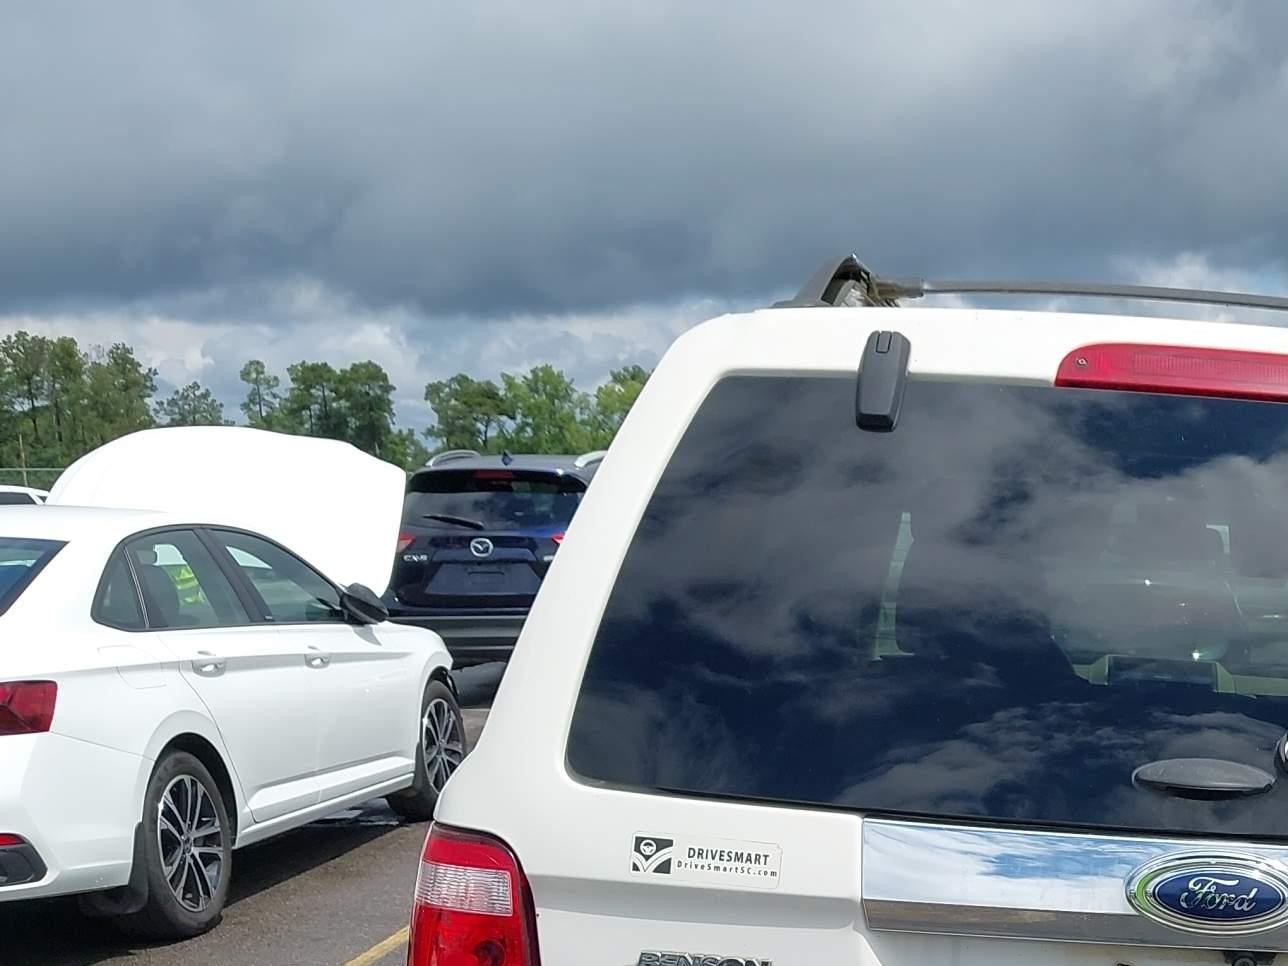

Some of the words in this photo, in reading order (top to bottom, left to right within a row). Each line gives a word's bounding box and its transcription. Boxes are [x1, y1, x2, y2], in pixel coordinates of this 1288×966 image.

[687, 847, 770, 866] DRIVESMART
[676, 860, 778, 877] DriveSmartSC.com
[1179, 876, 1259, 912] Ford
